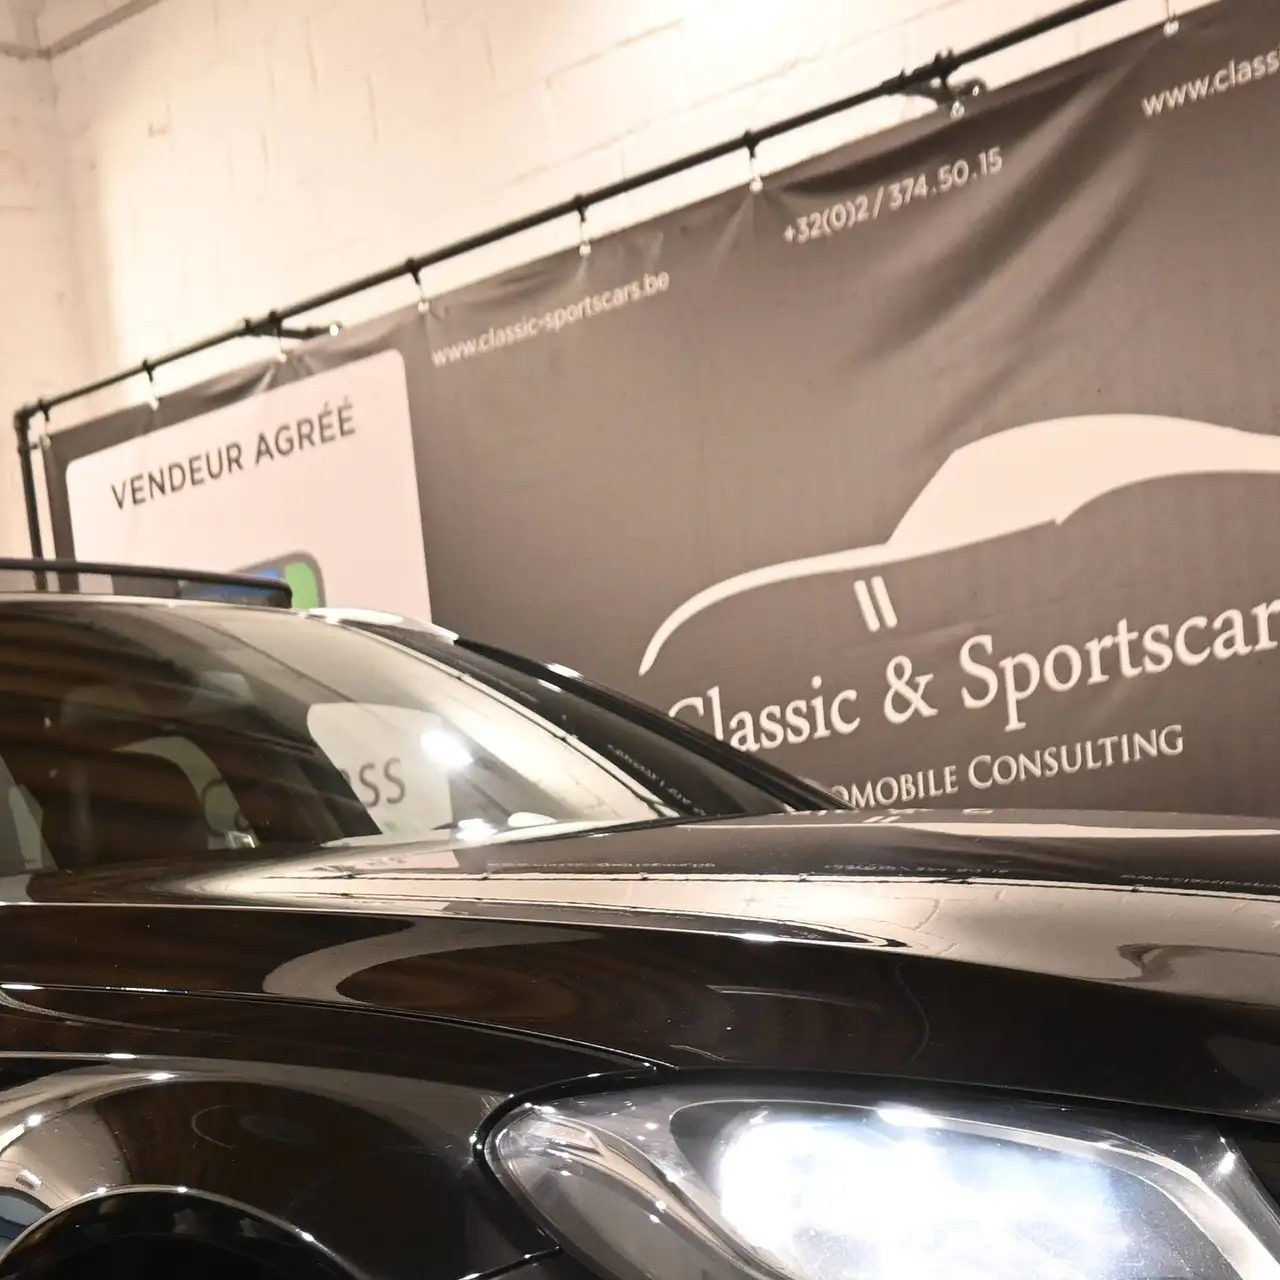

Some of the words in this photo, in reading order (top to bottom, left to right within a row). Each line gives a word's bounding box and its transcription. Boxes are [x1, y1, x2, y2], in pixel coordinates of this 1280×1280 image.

[430, 270, 671, 368] www.classic-sportscars.be
[110, 440, 244, 511] VENDEUR
[254, 401, 356, 470] AGRÉÉ
[882, 654, 938, 725] &
[967, 723, 1185, 790] CONSULTING
